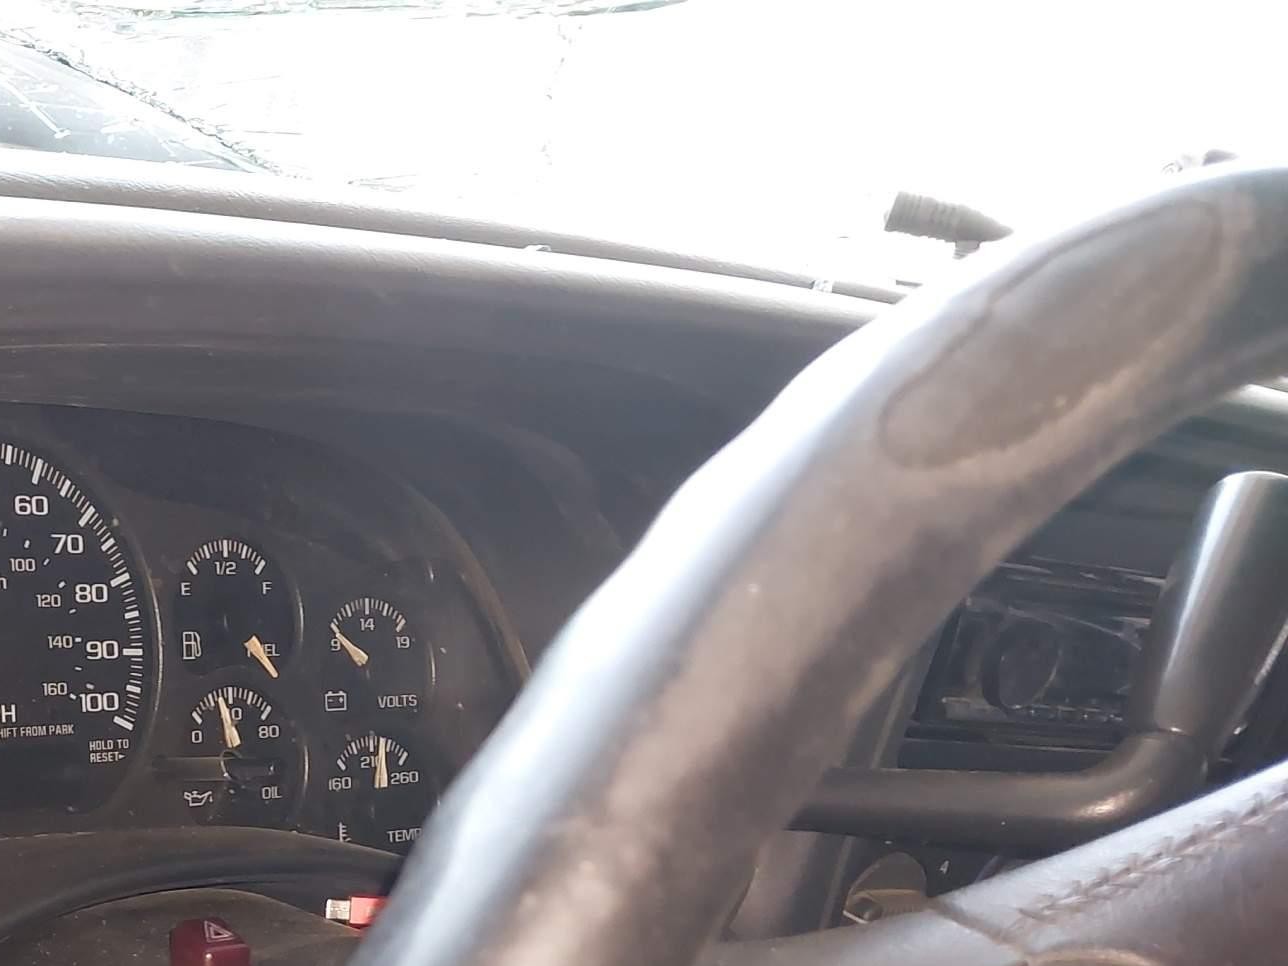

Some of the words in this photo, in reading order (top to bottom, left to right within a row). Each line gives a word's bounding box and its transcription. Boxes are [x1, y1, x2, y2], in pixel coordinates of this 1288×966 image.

[14, 496, 48, 515] 60
[51, 534, 83, 554] 70
[10, 558, 35, 572] 100
[214, 562, 236, 575] 1/2
[75, 584, 108, 602] 80
[181, 583, 191, 595] E
[262, 582, 272, 594] F
[36, 595, 61, 608] 120
[360, 618, 374, 630] 14
[48, 636, 73, 649] 140
[330, 639, 341, 651] 9
[396, 636, 410, 649] 19
[86, 641, 118, 659] 90
[43, 683, 67, 696] 160
[80, 693, 119, 712] 100
[378, 695, 417, 708] VOLTS
[20, 726, 46, 737] FROM
[48, 724, 74, 736] PARK
[191, 731, 202, 743] 0
[259, 726, 279, 738] 80
[89, 739, 114, 751] HOLD
[116, 739, 129, 749] TO
[90, 751, 119, 763] RESET
[329, 777, 351, 789] 160
[391, 772, 418, 784] 260
[262, 786, 282, 799] OIL
